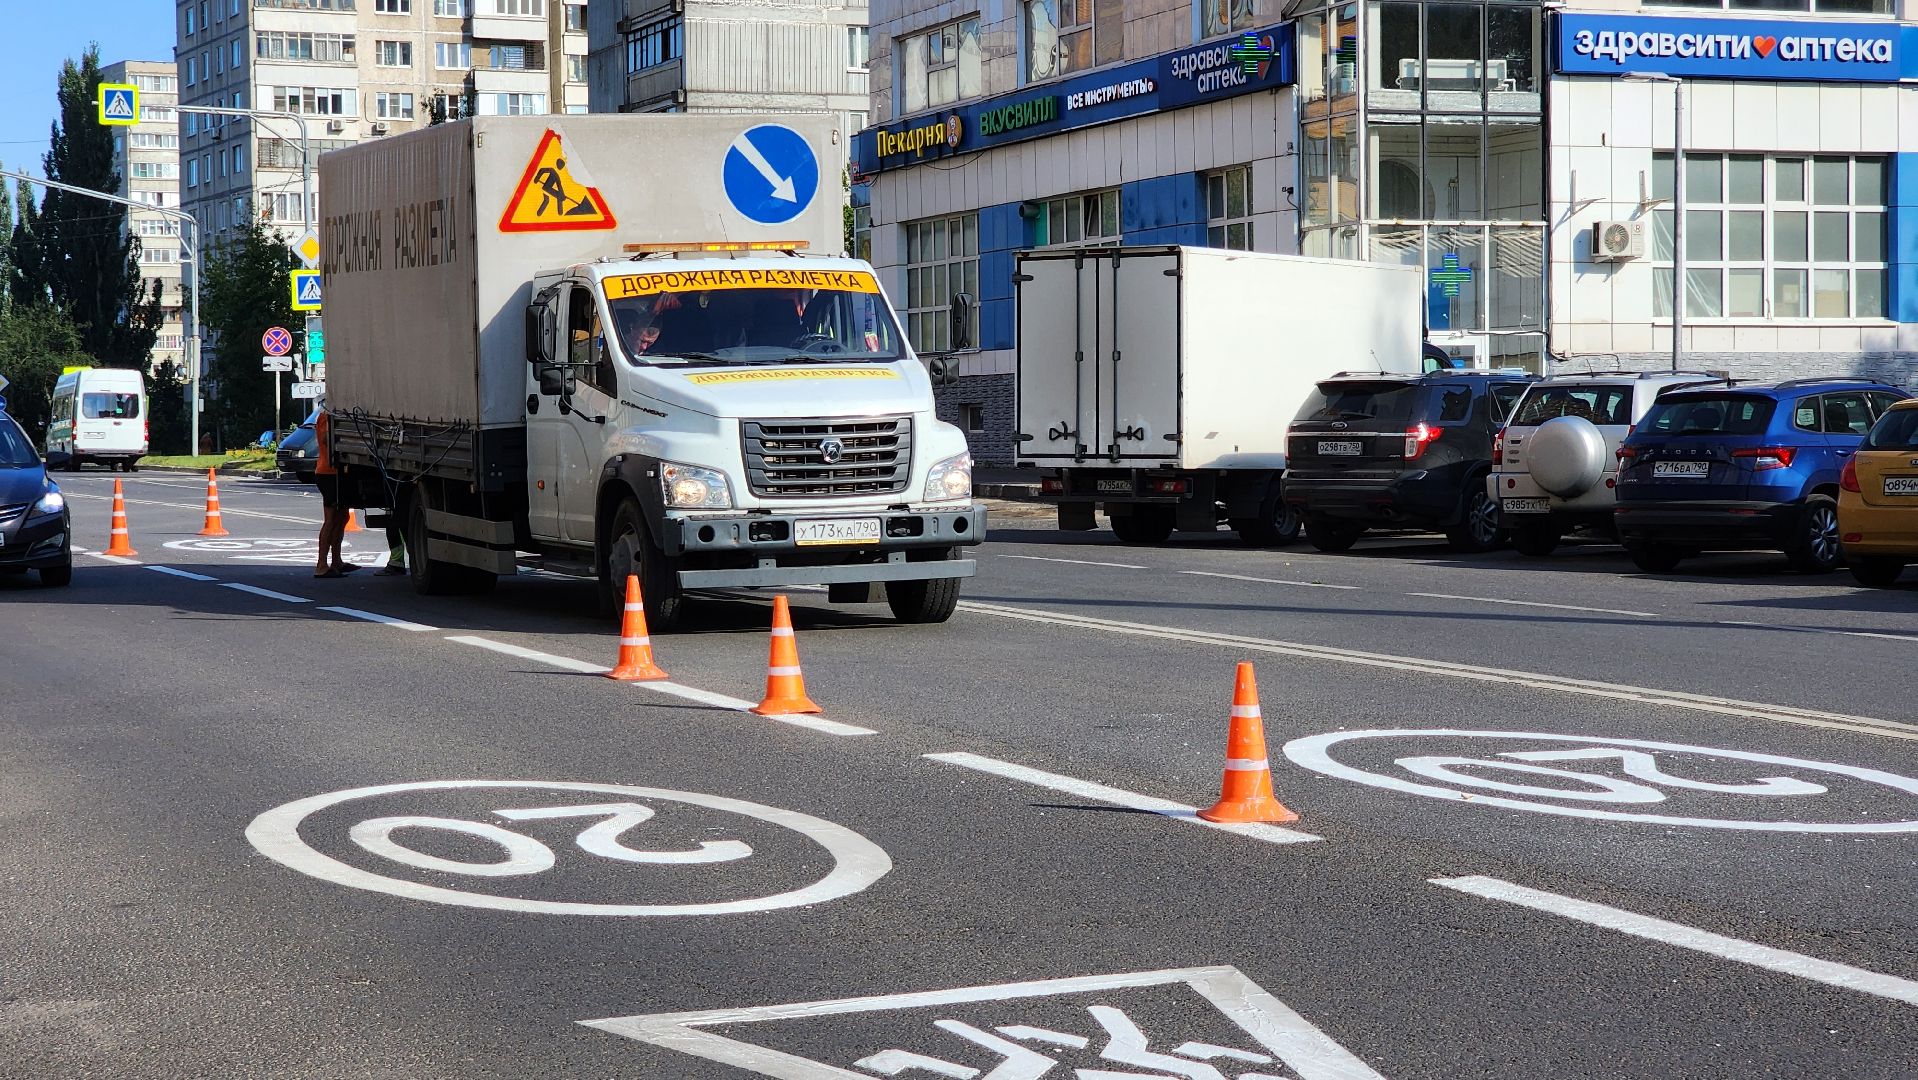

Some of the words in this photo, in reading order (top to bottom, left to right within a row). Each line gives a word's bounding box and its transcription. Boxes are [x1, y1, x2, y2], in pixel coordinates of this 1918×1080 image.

[1171, 43, 1241, 80] здравси
[1574, 30, 1750, 63] здравсити
[1779, 35, 1893, 62] аптека
[1067, 92, 1084, 111] ВСЕ
[1084, 77, 1148, 106] ИНСТРУМЕНТЫ
[979, 96, 1057, 137] ВКУСВИЛЛ
[876, 123, 946, 158] Пекарня
[323, 209, 382, 287] ДОРОЖНАЯ
[621, 271, 745, 295] ДОРОЖНАЯ
[750, 270, 863, 289] РАЗМЕТКА
[695, 370, 796, 384] ДОРОЖНАЯ
[799, 369, 893, 378] РАЗМЕТКА
[799, 523, 854, 539] У173КА
[855, 521, 877, 533] 790
[1394, 748, 1829, 803] 20
[349, 802, 753, 877] 20
